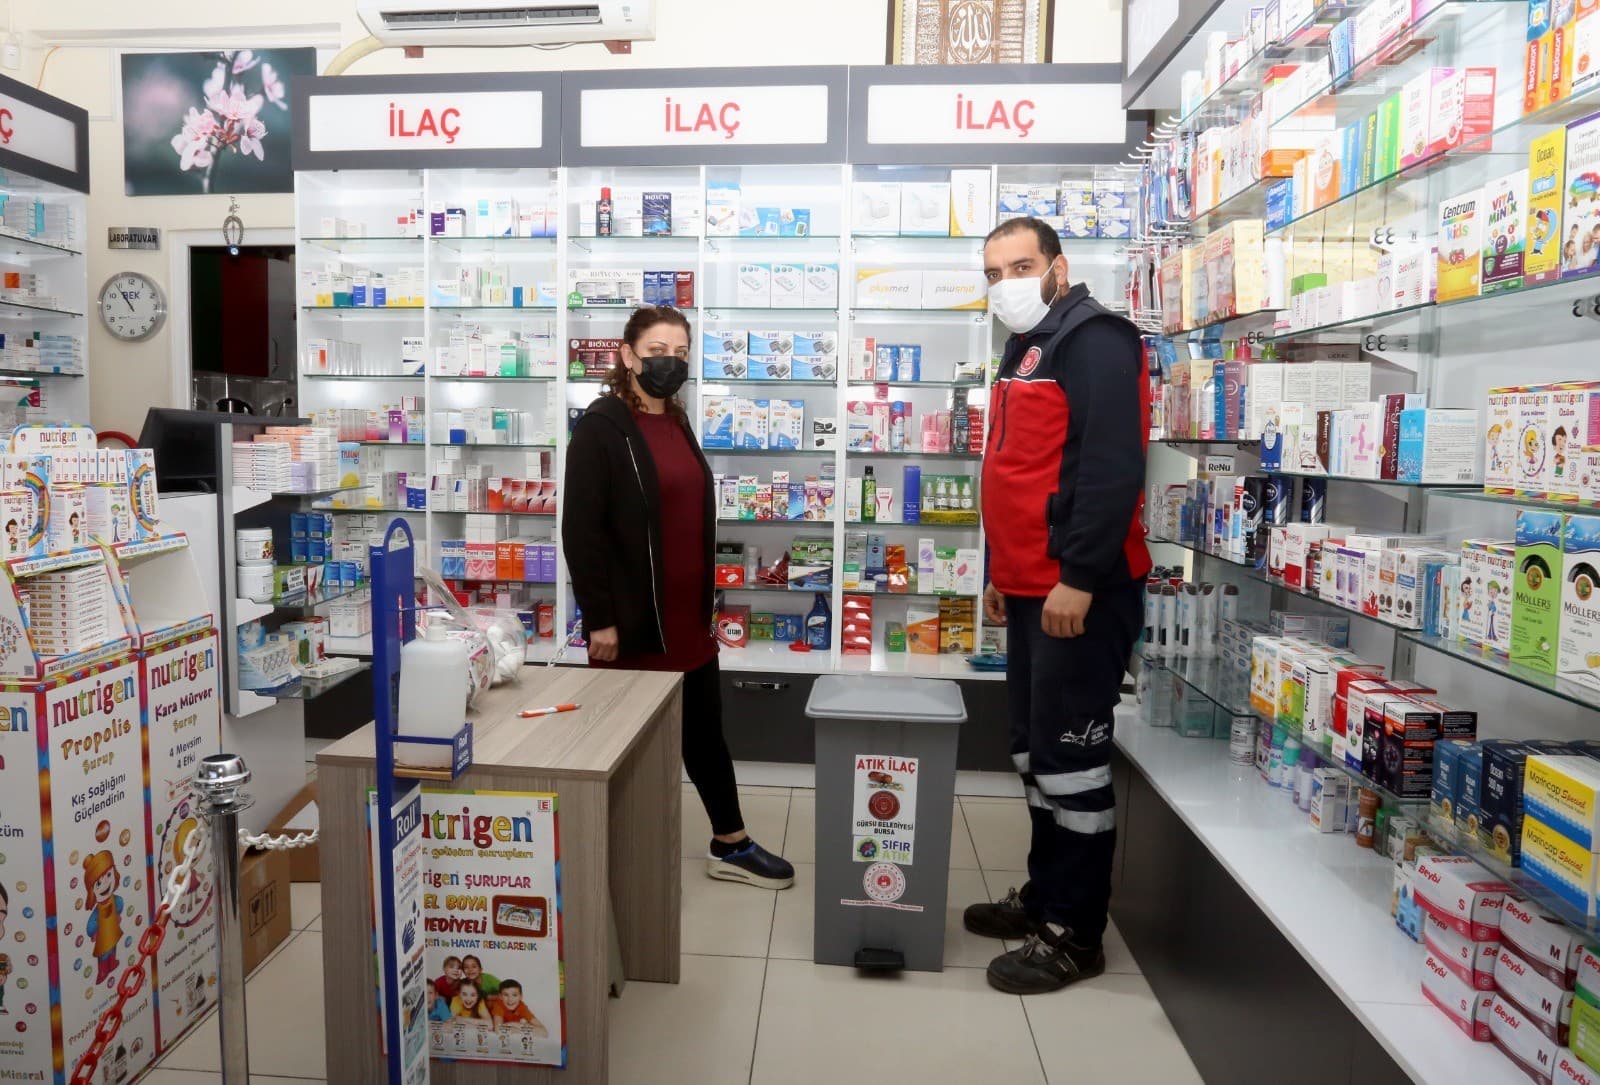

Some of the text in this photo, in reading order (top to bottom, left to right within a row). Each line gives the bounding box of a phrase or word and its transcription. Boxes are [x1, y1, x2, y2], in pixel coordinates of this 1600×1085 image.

[389, 102, 461, 144] İLAÇ
[665, 97, 741, 138] İLAÇ
[956, 93, 1035, 138] İLAÇ
[1443, 200, 1476, 220] Centrum
[109, 233, 158, 244] LABORATUVAR
[39, 429, 77, 445] nutrigen
[1208, 463, 1231, 472] ReNu
[151, 647, 214, 690] nutrigen
[52, 675, 136, 728] nutrigen
[155, 687, 213, 722] Kara Mürver
[60, 717, 132, 761] Propolis
[176, 734, 202, 754] Mevsim
[856, 757, 917, 774] ATIK İLAÇ
[71, 773, 127, 808] Kış Sağlığını
[74, 791, 126, 823] Güçlendirin
[396, 802, 416, 841] Roll
[856, 819, 914, 832] GÜRSU BELEDİYESİ
[873, 827, 895, 836] BURSA
[882, 839, 911, 852] SIFIR
[464, 874, 532, 890] ŞURUPLAR
[1418, 864, 1442, 884] Beybi
[445, 894, 488, 912] BOYA
[1458, 898, 1466, 911] S
[1505, 902, 1533, 925] Beybi
[451, 939, 481, 949] HAYAT
[482, 940, 538, 951] RENGARENK
[1461, 946, 1468, 959] S
[1549, 944, 1561, 961] M
[1425, 956, 1448, 979] Beybi
[1500, 952, 1526, 977] Beybi
[1460, 999, 1467, 1012] S
[1541, 998, 1552, 1014] M
[1493, 1004, 1521, 1029] Beybi
[1537, 1049, 1549, 1065] M
